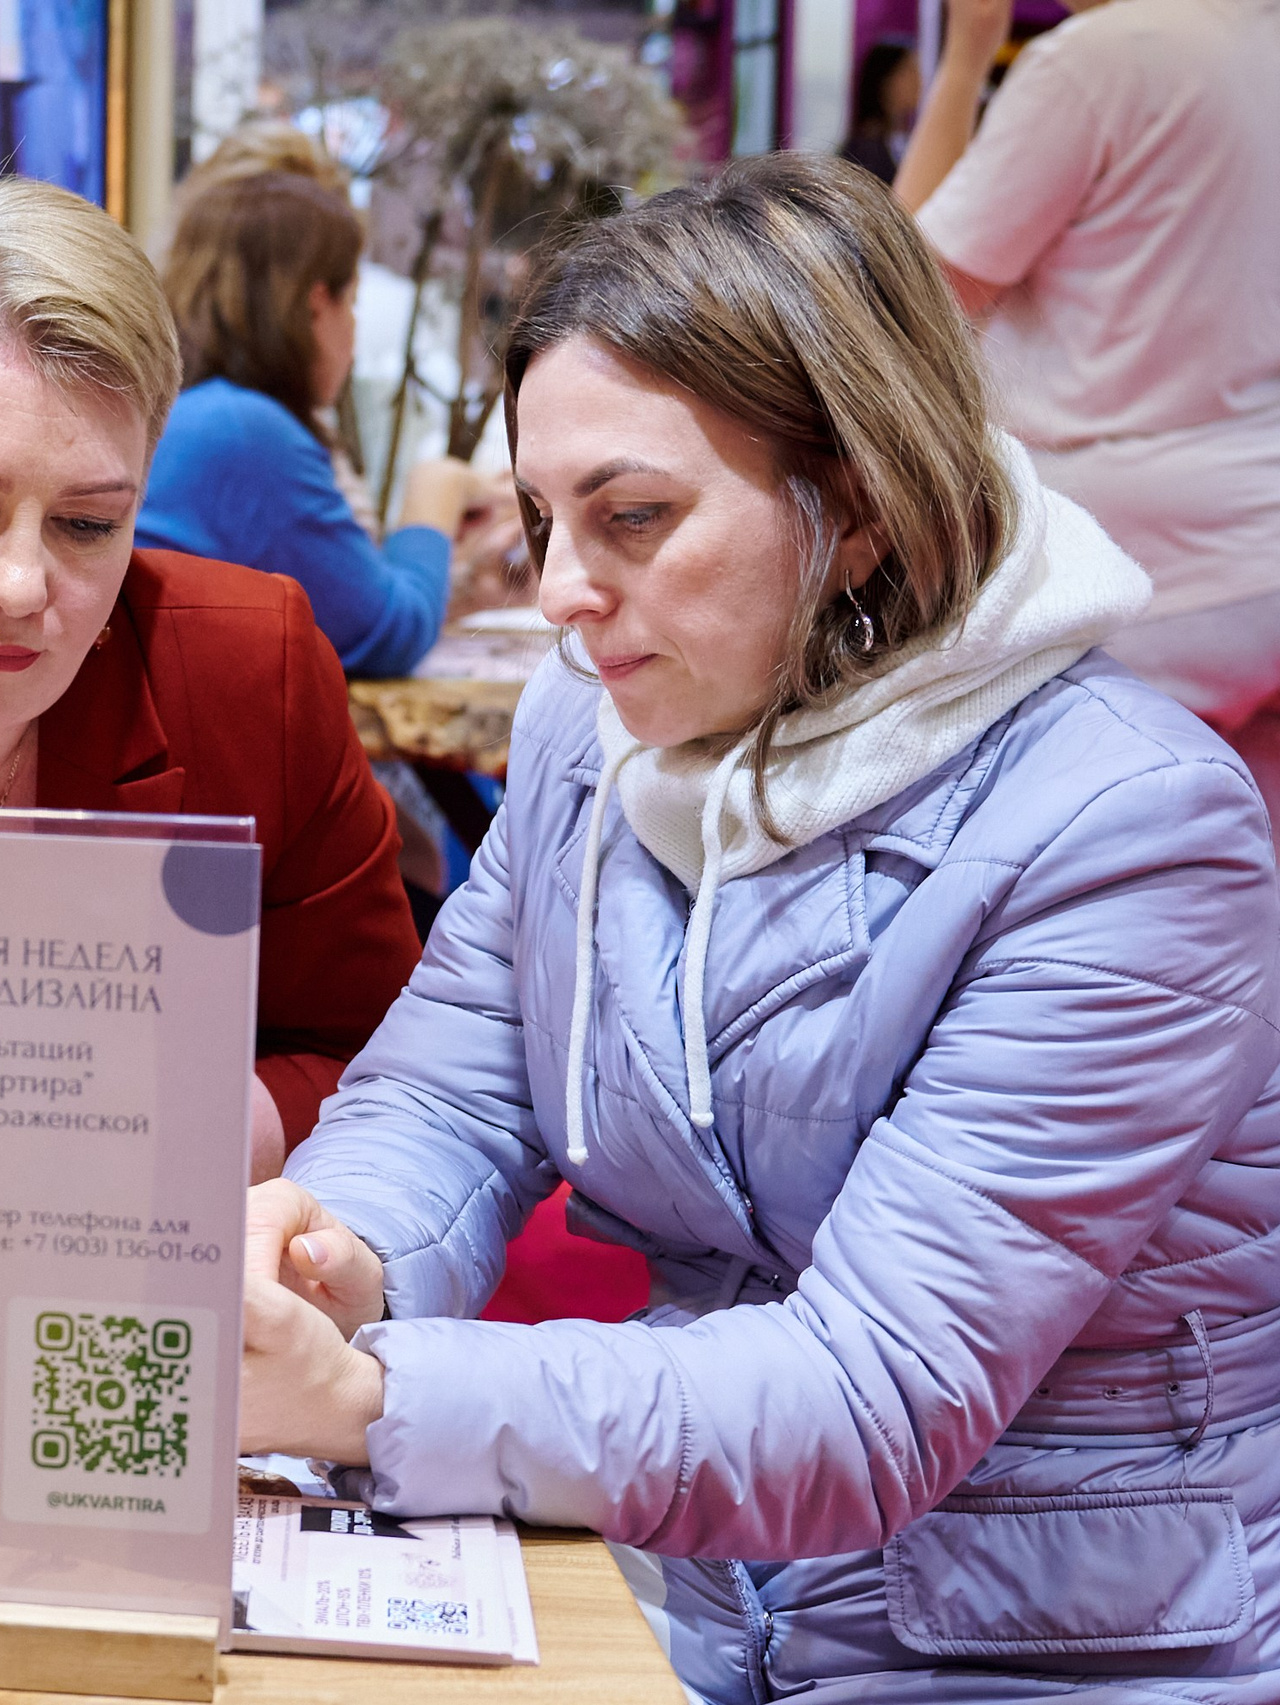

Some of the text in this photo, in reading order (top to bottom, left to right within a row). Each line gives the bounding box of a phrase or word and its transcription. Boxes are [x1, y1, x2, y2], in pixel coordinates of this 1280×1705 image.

[22, 940, 163, 975] НЕДЕЛЯ
[30, 1210, 141, 1235] телефона
[148, 1219, 190, 1235] для
[22, 1233, 47, 1251] +7
[53, 1235, 109, 1257] (903)
[115, 1240, 221, 1265] 136-01-60
[47, 1491, 166, 1514] @UKVARTIRA
